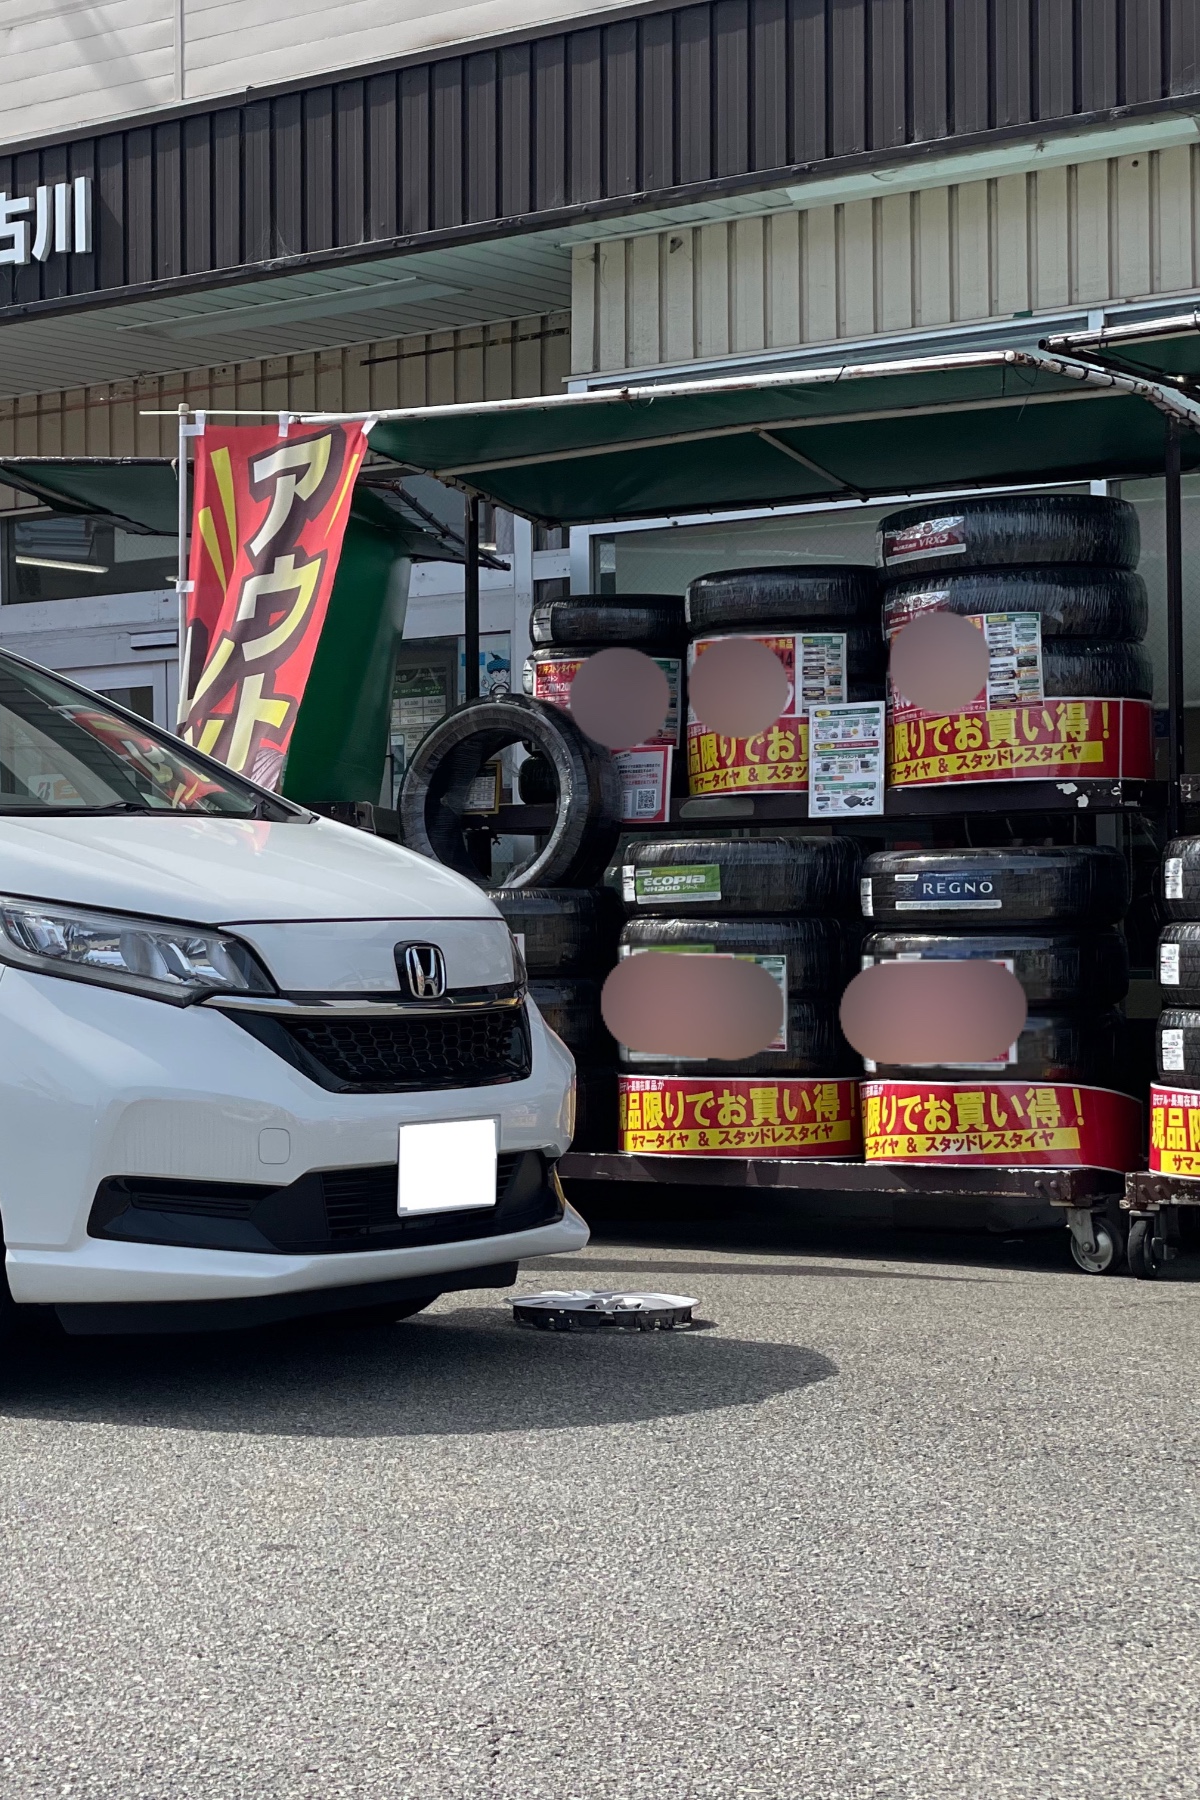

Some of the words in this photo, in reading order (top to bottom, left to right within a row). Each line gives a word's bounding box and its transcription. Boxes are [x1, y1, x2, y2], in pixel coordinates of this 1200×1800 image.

[919, 533, 949, 548] VRX3
[938, 757, 949, 772] &
[956, 744, 1082, 770] スタッドレスタイヤ
[748, 768, 759, 782] &
[923, 881, 993, 895] REGNO
[631, 1133, 689, 1149] サマータイヤ
[698, 1133, 709, 1146] &
[718, 1124, 834, 1145] スタッドレスタイヤ
[906, 1138, 917, 1153] &
[926, 1131, 1055, 1151] スタッドレスタイヤ
